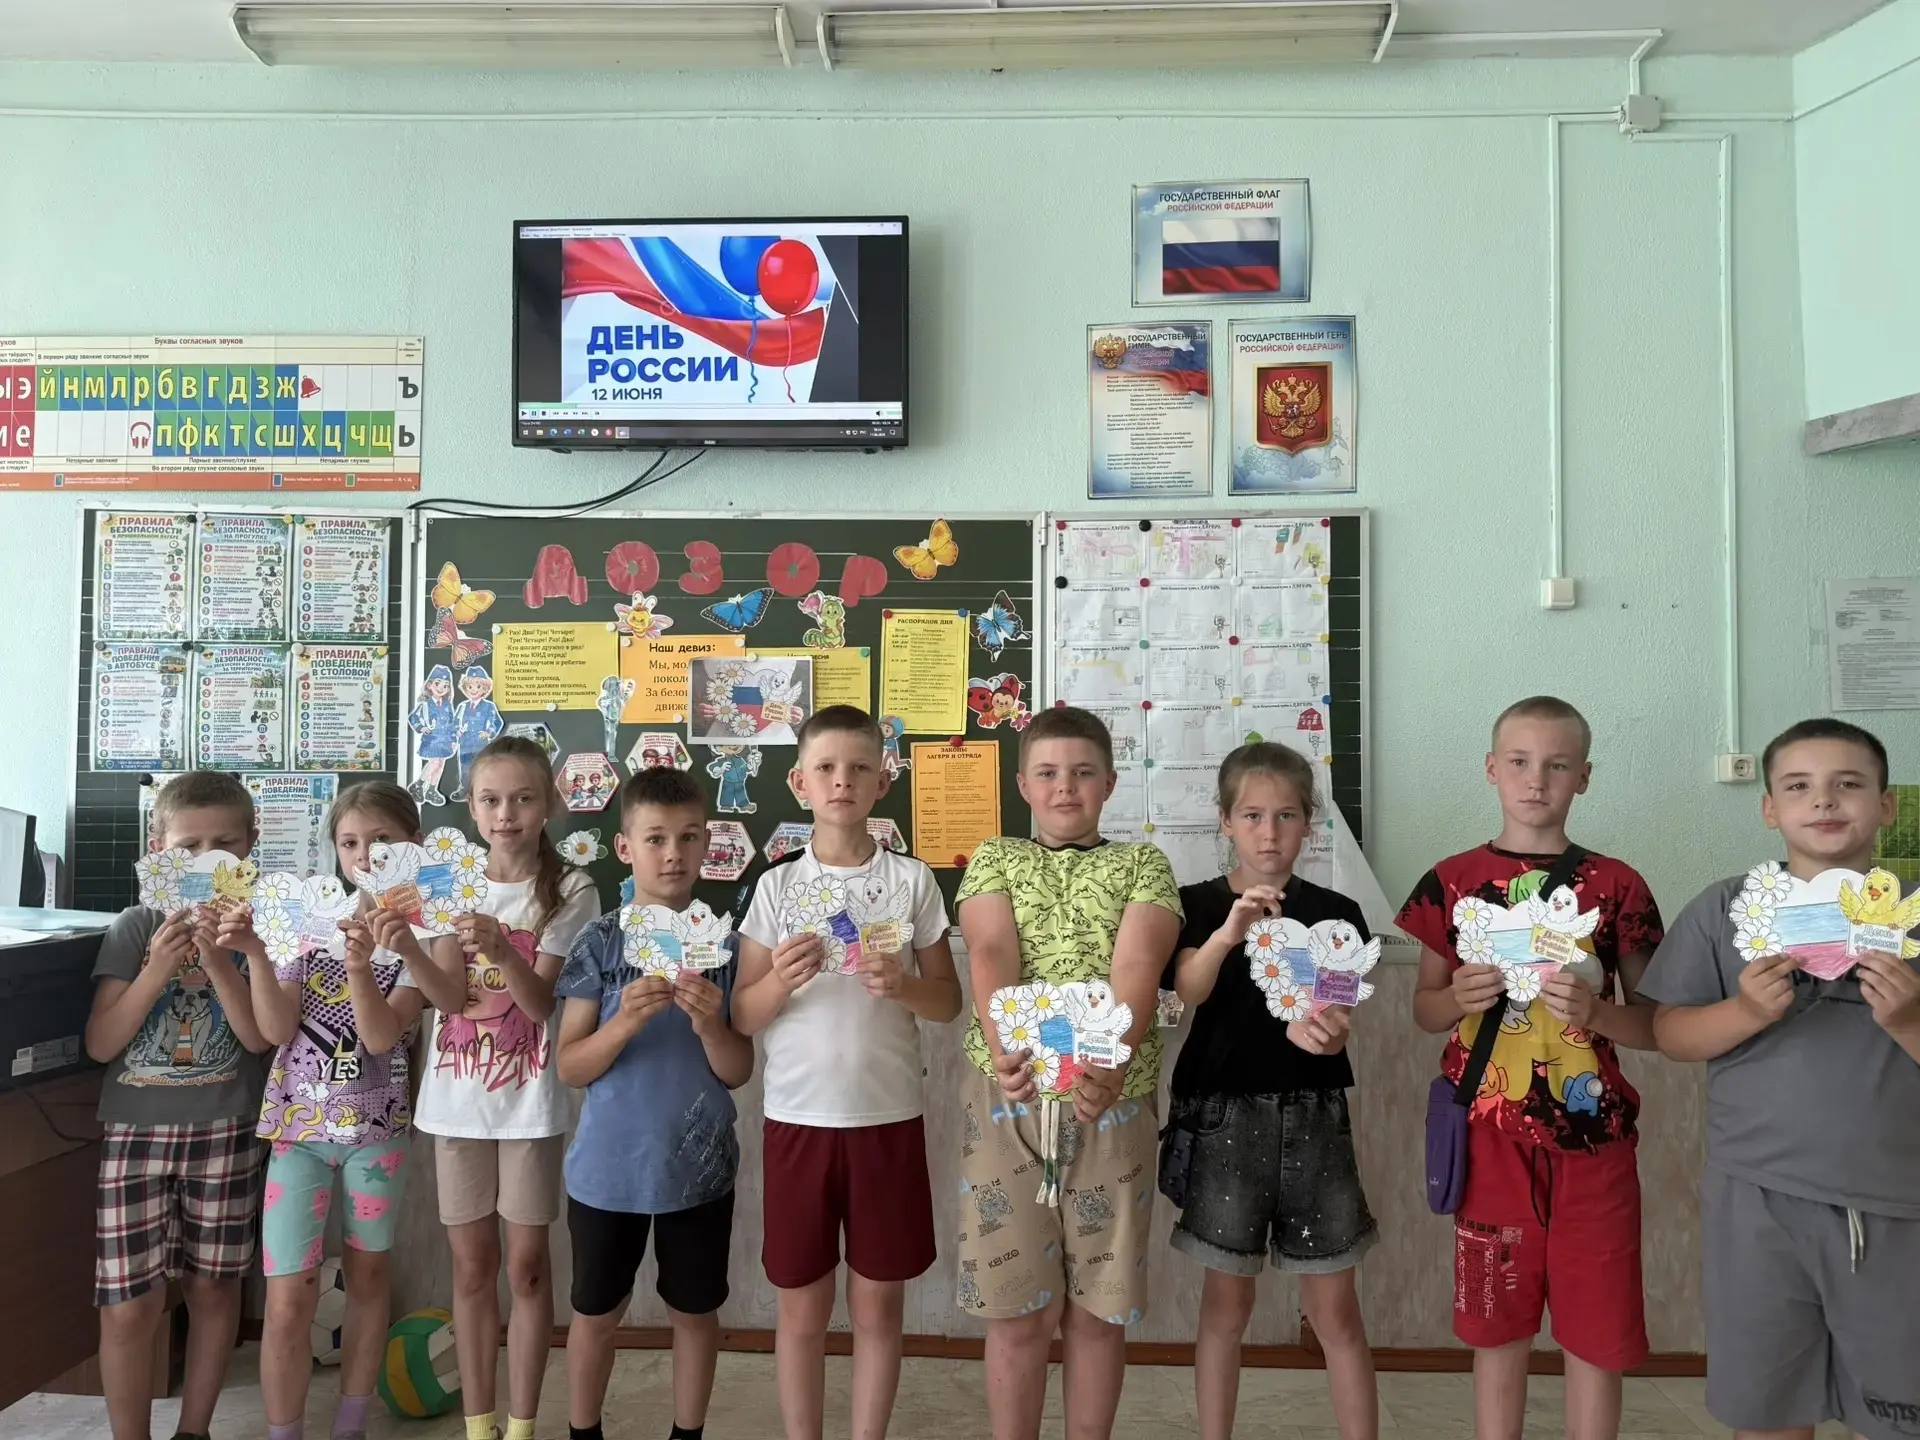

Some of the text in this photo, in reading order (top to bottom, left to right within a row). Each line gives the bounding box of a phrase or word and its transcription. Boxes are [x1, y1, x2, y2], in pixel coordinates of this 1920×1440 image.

[1160, 189, 1280, 202] ГОСУДАРСТВЕННЫЙ ФЛАГ
[1168, 202, 1274, 212] РОССИЙСКОЙ ФЕДЕРАЦИИ
[586, 325, 684, 355] ДЕНЬ
[1128, 332, 1206, 342] ГОСУДАРСТВЕННЫЙ
[1236, 330, 1324, 342] ГОСУДАРСТВЕННЫЙ
[1240, 343, 1294, 352] РОССИЙСКОЙ
[588, 357, 738, 383] РОССИИ
[18, 368, 296, 406] э й н м л р б в г д з ж
[592, 388, 662, 400] 12 ИЮНЯ
[16, 425, 30, 446] е
[156, 425, 172, 446] п
[178, 417, 198, 454] ф
[204, 425, 219, 446] к
[230, 425, 244, 446] т
[255, 424, 267, 446] с
[274, 425, 294, 446] ш
[302, 425, 316, 446] х
[325, 425, 341, 452] ц
[351, 425, 365, 446] ч
[372, 424, 392, 452] щ
[120, 518, 172, 526] ПРАВИЛА
[321, 520, 366, 528] ПРАВИЛА
[650, 643, 715, 653] Наш девиз:
[316, 650, 367, 659] ПРАВИЛА
[311, 660, 372, 668] ПОВЕДЕНИЯ
[650, 660, 669, 670] Мы,
[320, 668, 370, 676] СТОЛОВОЙ
[646, 688, 657, 696] За
[765, 707, 784, 715] России
[266, 778, 308, 786] ПРАВИЛА
[871, 924, 892, 934] День
[1862, 925, 1894, 939] День
[866, 932, 896, 942] России
[1544, 930, 1568, 944] День
[1854, 933, 1898, 949] России
[691, 944, 712, 952] День
[1536, 935, 1570, 953] России
[1547, 951, 1567, 962] июня
[1327, 972, 1351, 982] День
[1320, 980, 1353, 992] России
[1084, 1033, 1109, 1044] День
[1078, 1042, 1113, 1055] России
[434, 1032, 550, 1092] AMAZING
[318, 1057, 362, 1081] YES
[1013, 1159, 1040, 1176] KENZ
[1118, 1164, 1143, 1185] KENZO
[988, 1249, 1020, 1269] KENZO
[1086, 1252, 1114, 1266] KENZO
